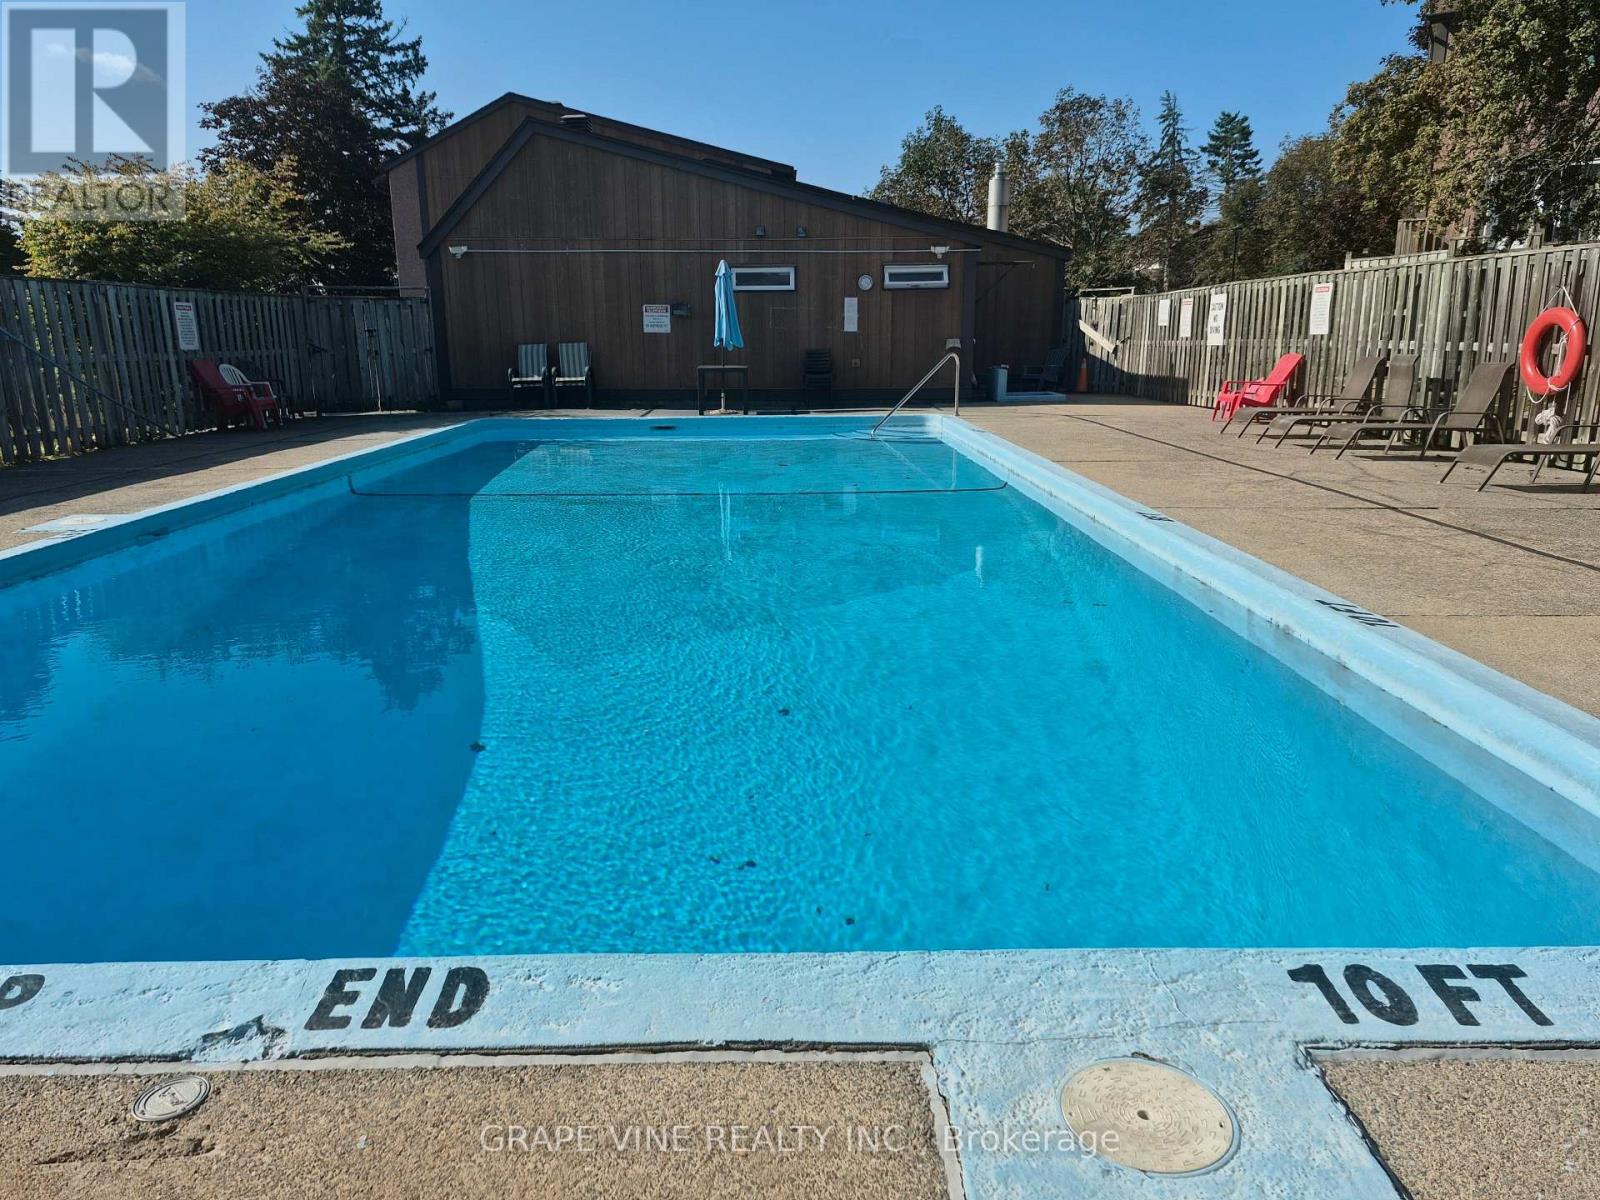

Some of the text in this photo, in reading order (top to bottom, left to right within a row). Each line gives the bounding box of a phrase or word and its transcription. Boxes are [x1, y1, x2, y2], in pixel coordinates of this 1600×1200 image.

[304, 966, 491, 1031] END
[1287, 963, 1555, 1027] 10 FT
